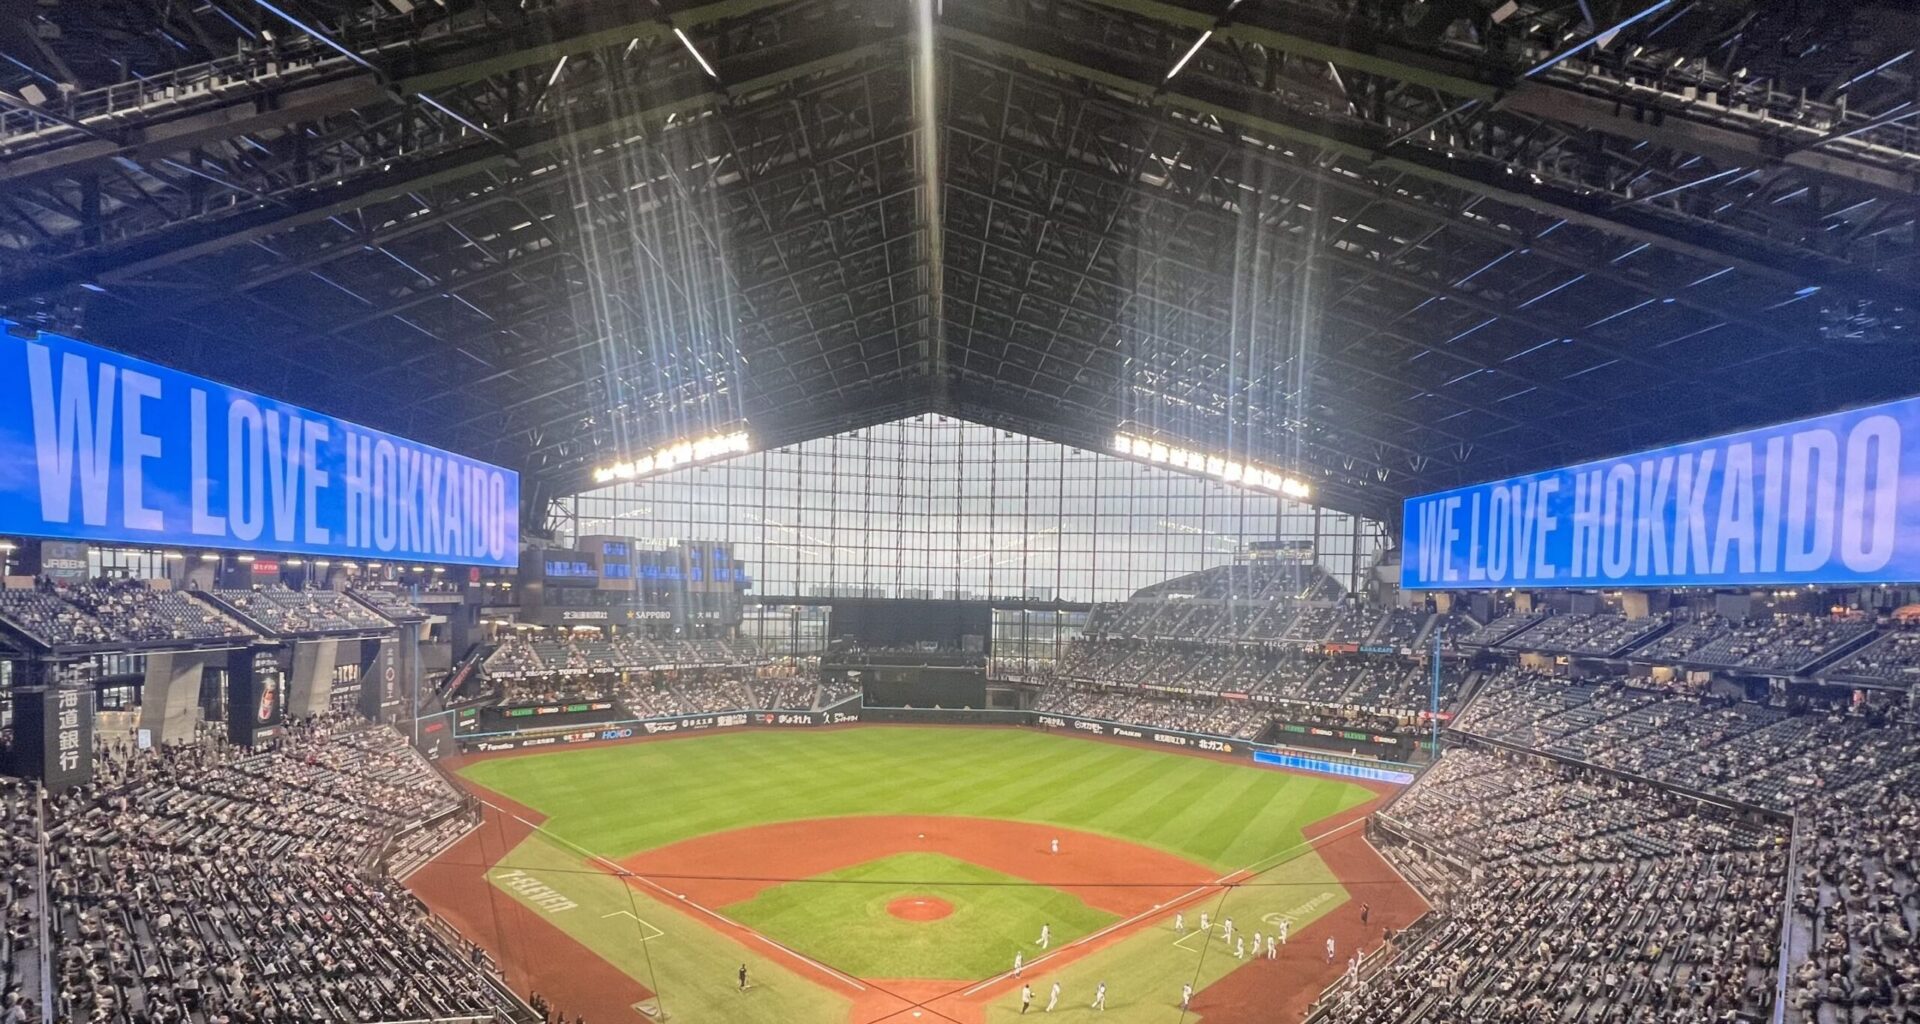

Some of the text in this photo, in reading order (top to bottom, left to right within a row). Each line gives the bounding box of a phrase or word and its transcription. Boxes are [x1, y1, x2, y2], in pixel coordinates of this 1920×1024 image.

[27, 341, 506, 561] WE LOVE HOKKAIDO
[1418, 415, 1901, 583] WE LOVE HOKKAIDO
[42, 559, 87, 569] JR西日本
[635, 610, 671, 620] SAPPORO
[558, 668, 588, 676] TOPPAN
[487, 742, 515, 751] Fanatics
[1198, 738, 1224, 752] 北ガス
[496, 869, 579, 914] 7-ELEVEN
